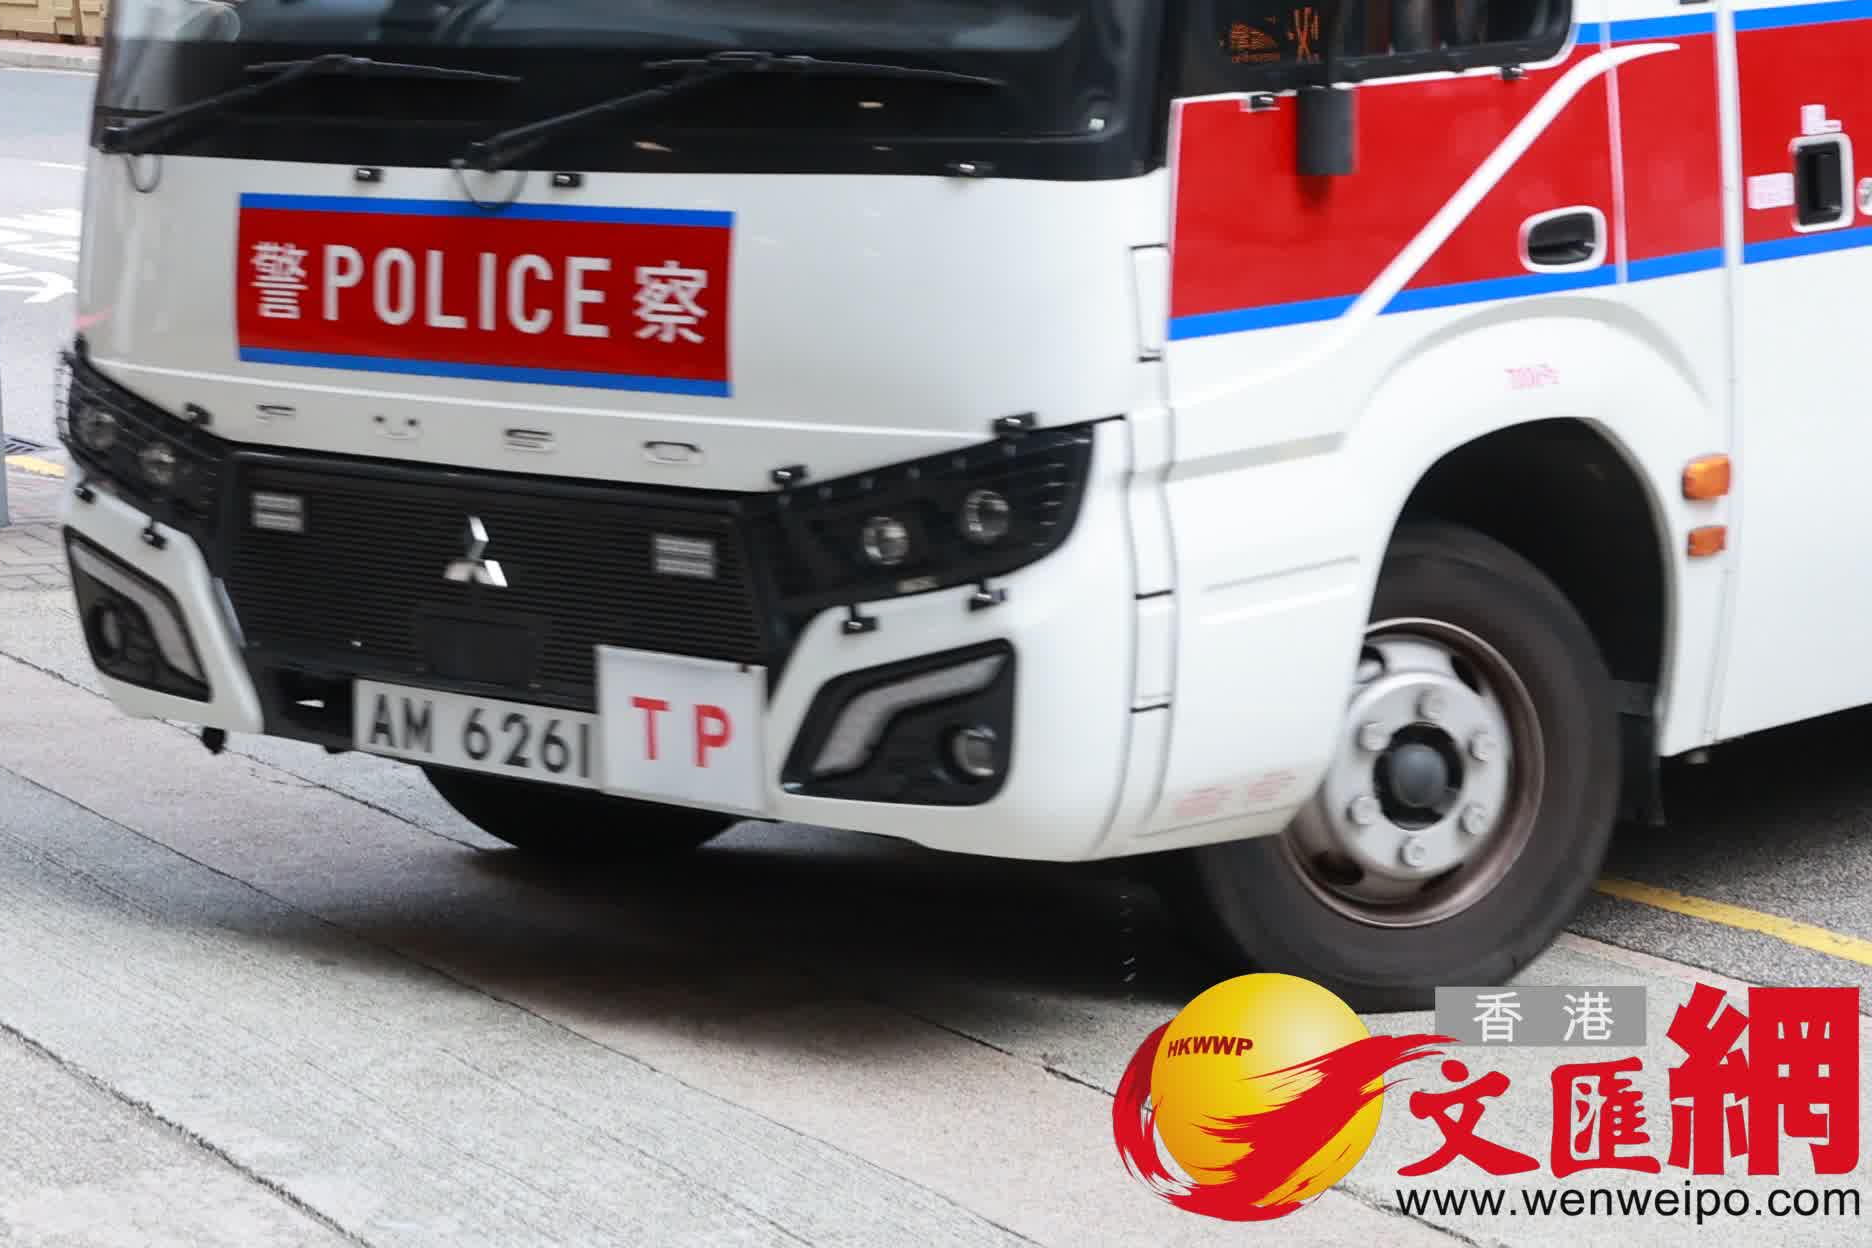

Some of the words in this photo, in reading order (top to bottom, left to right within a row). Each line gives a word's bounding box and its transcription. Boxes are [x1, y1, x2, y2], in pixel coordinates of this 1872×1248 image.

[250, 241, 309, 320] 警
[323, 244, 611, 339] POLICE
[634, 260, 708, 344] 察
[369, 693, 433, 755] AM
[462, 708, 590, 778] 6261
